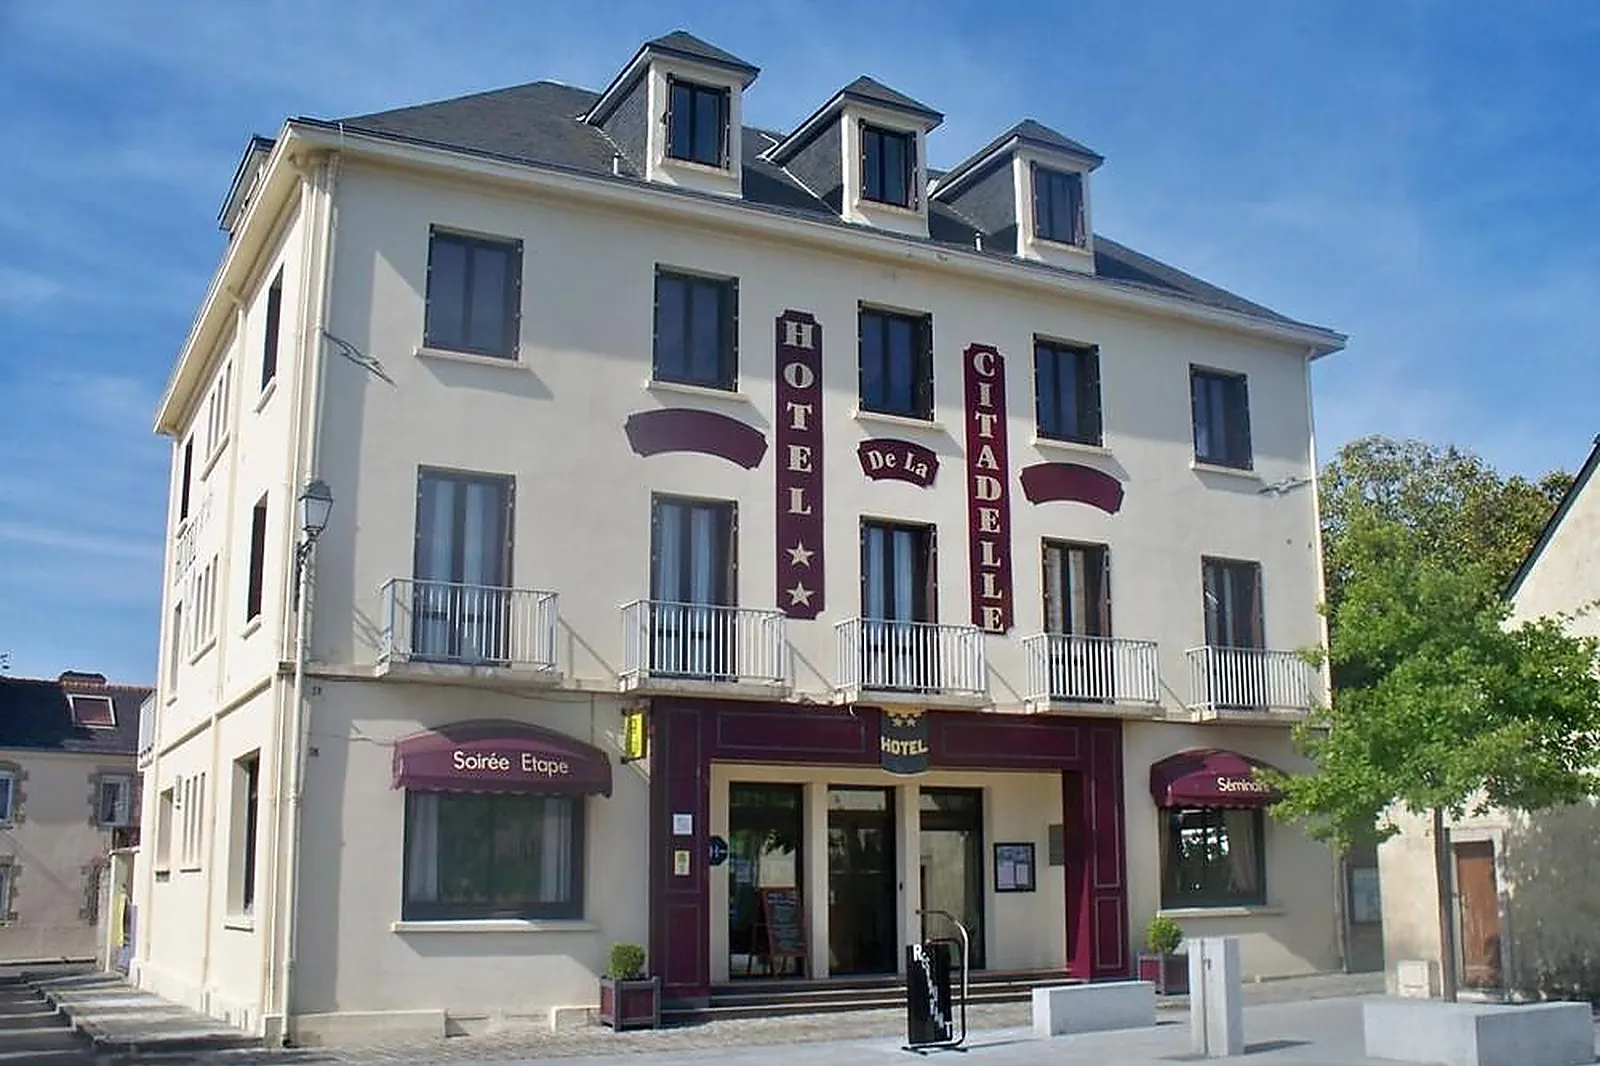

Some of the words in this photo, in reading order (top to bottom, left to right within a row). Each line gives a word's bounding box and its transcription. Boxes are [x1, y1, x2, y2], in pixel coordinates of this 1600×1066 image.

[783, 320, 815, 516] HOTEL
[868, 450, 897, 470] De
[904, 452, 929, 479] La
[973, 351, 1003, 633] CITADELLE
[881, 735, 930, 756] HOTEL
[453, 750, 511, 771] Soirée
[521, 752, 570, 778] Etape
